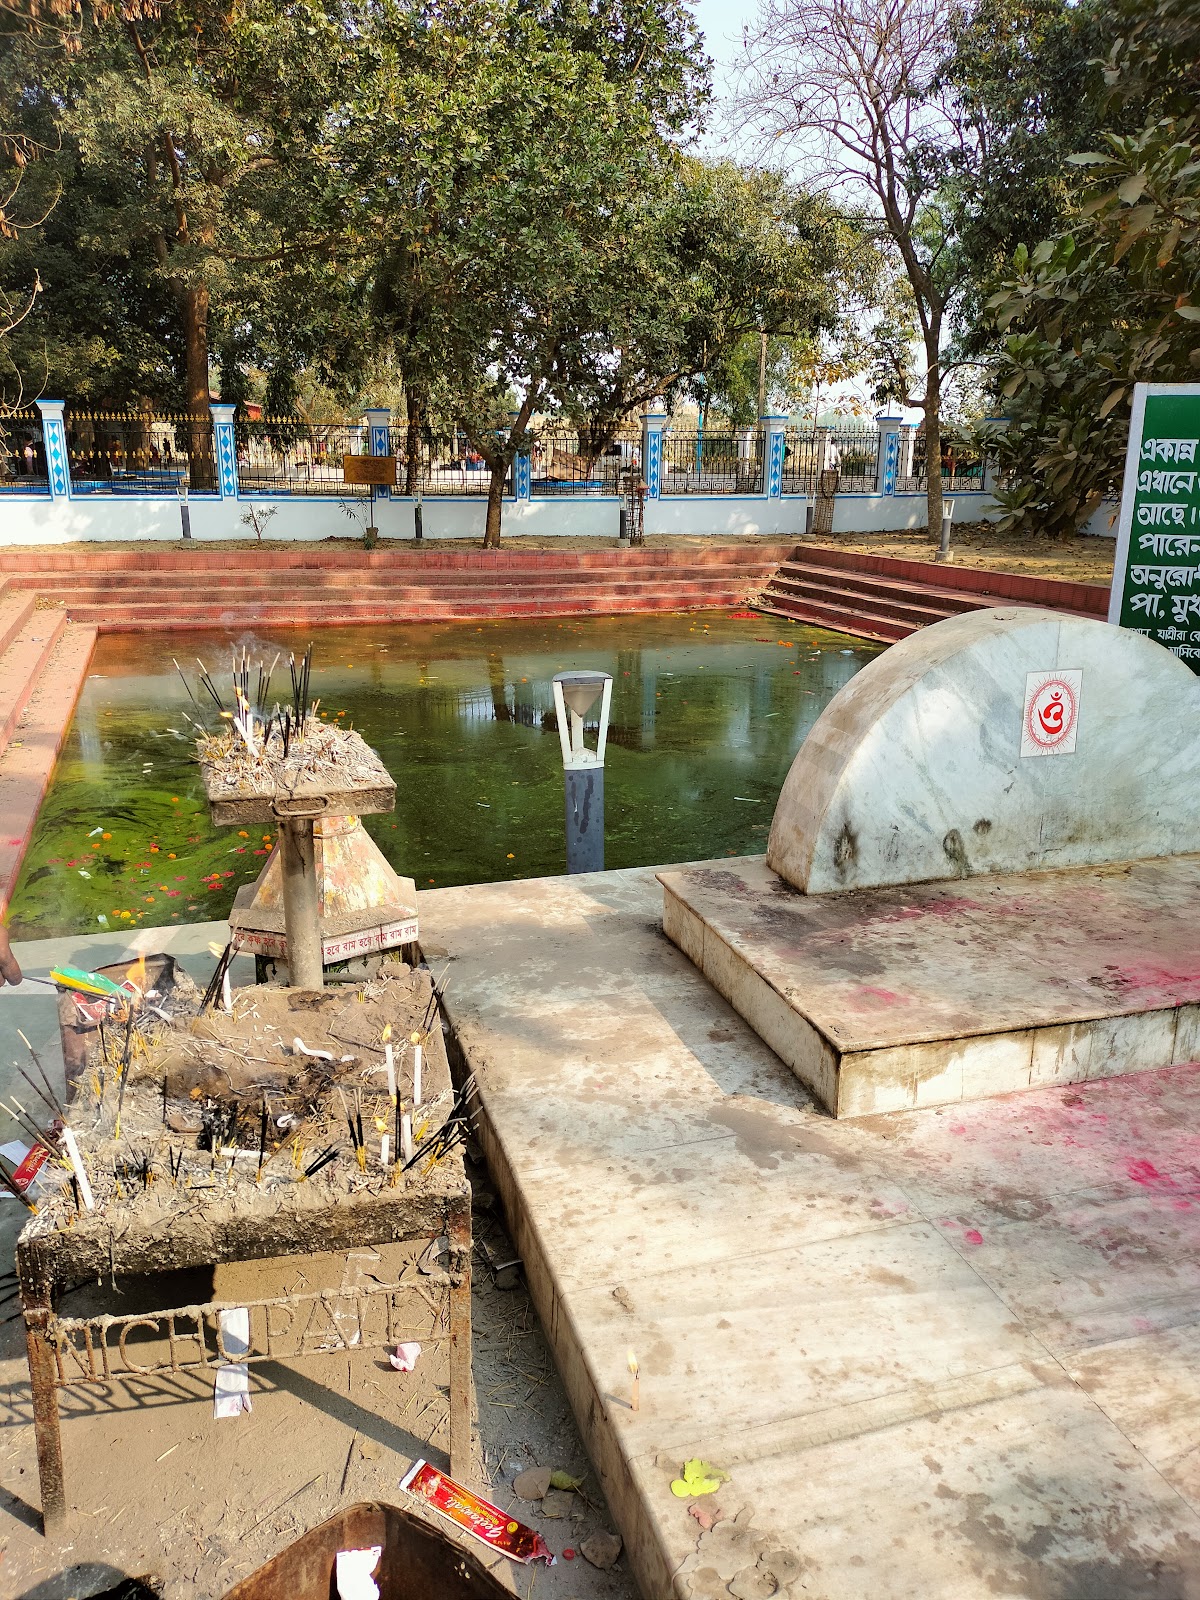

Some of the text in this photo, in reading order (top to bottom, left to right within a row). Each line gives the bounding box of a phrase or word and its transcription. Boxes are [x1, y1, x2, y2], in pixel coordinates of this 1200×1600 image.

[1136, 470, 1198, 494] এখানে
[1129, 593, 1165, 619] পা,
[443, 1496, 505, 1538] Geetanjali
